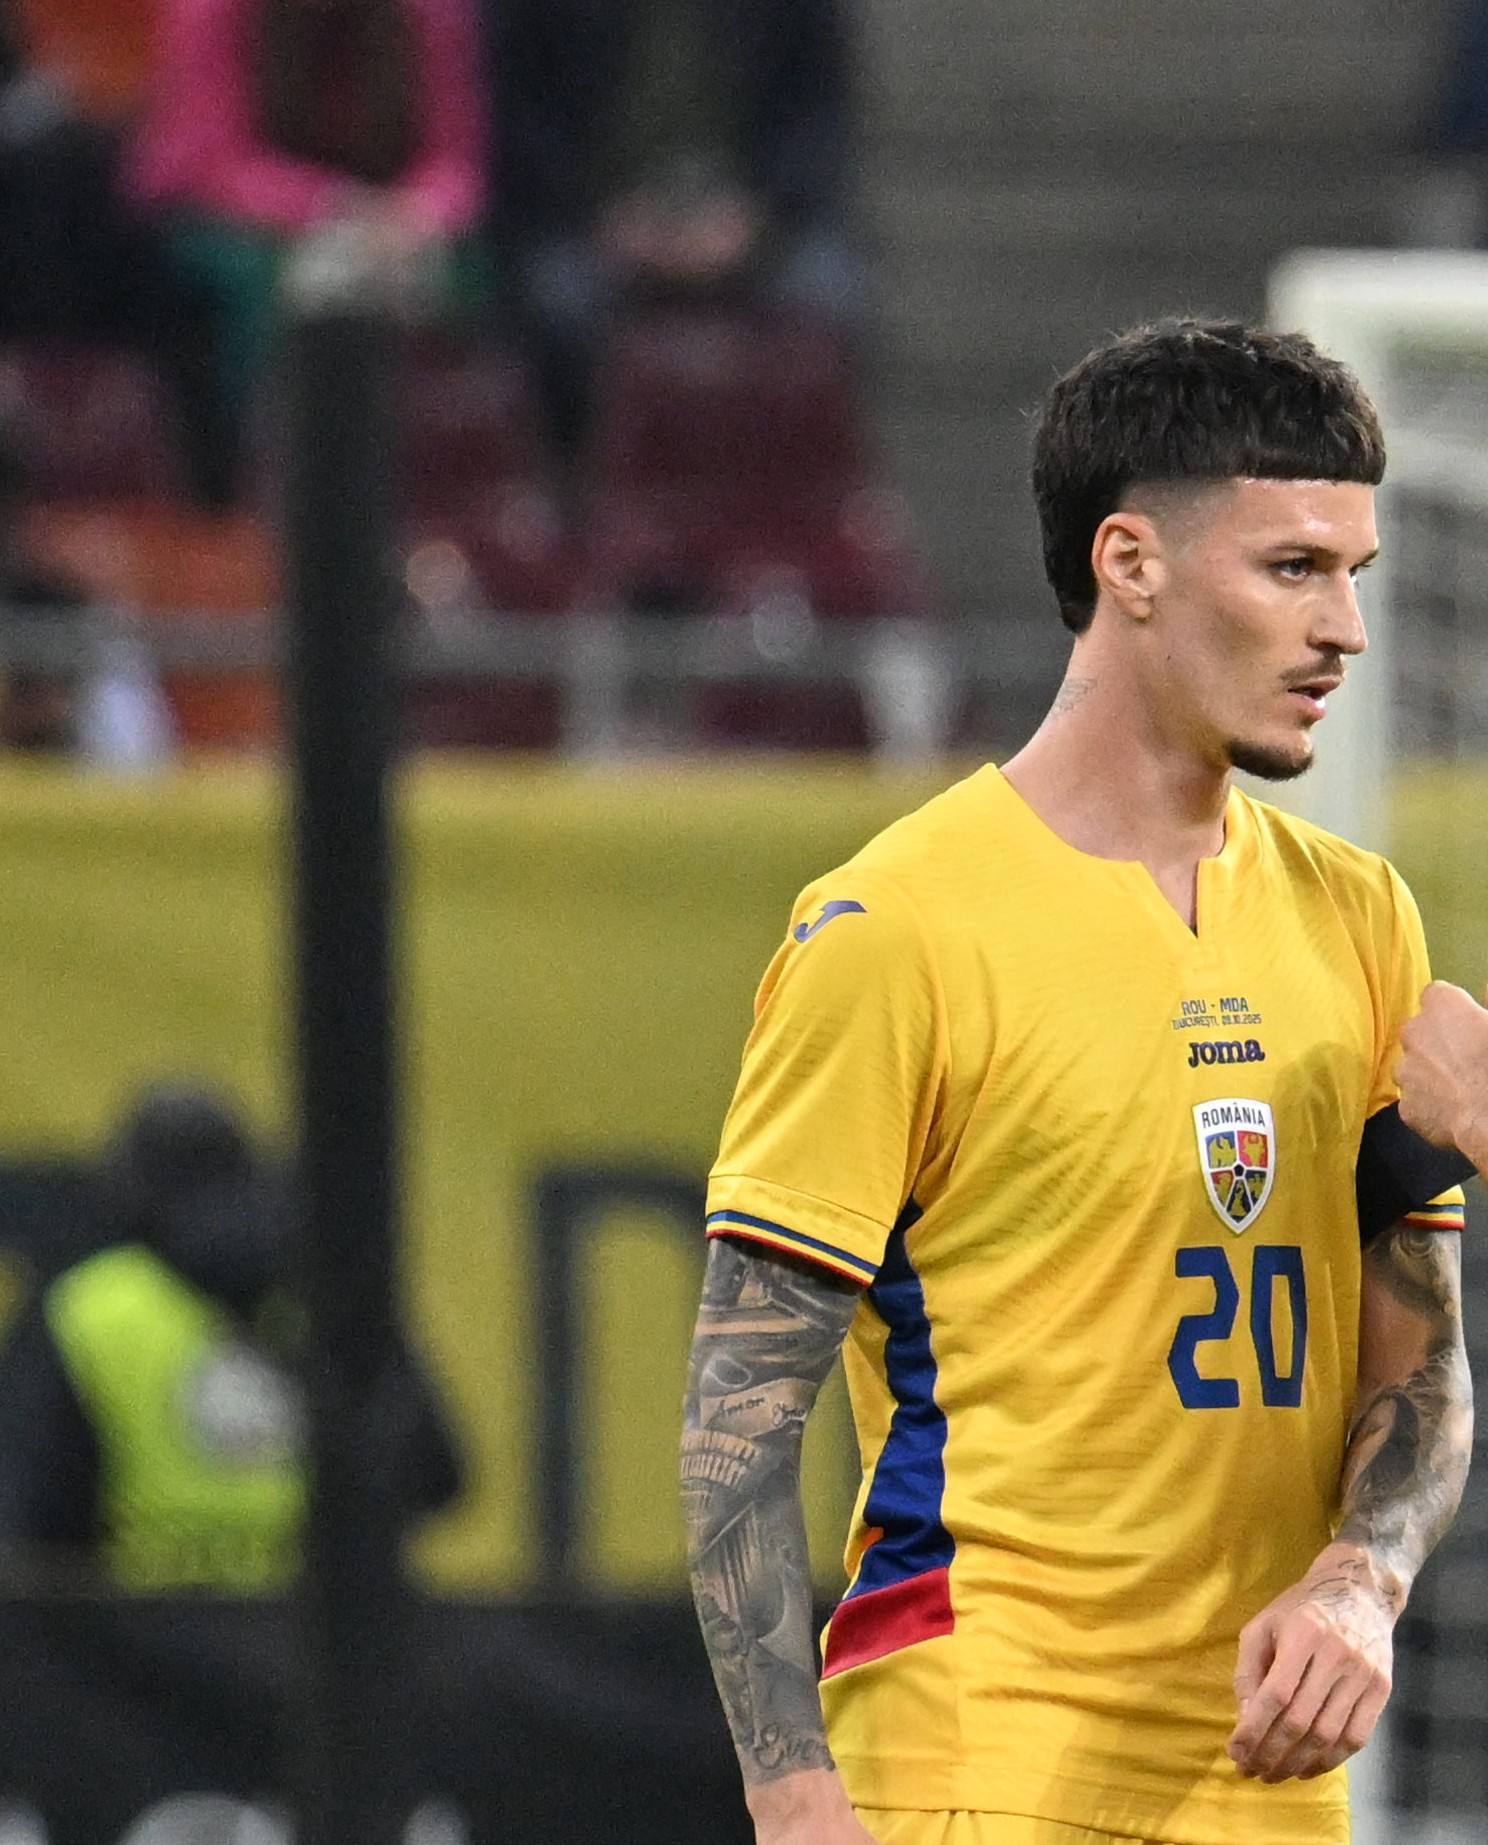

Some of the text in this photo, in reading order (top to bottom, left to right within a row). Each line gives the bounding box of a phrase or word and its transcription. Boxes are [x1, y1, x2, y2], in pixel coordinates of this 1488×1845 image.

[1181, 1000, 1207, 1015] ROU
[1219, 997, 1249, 1012] MDA
[1201, 1101, 1266, 1129] ROMÂNIA
[1167, 1245, 1308, 1409] 20
